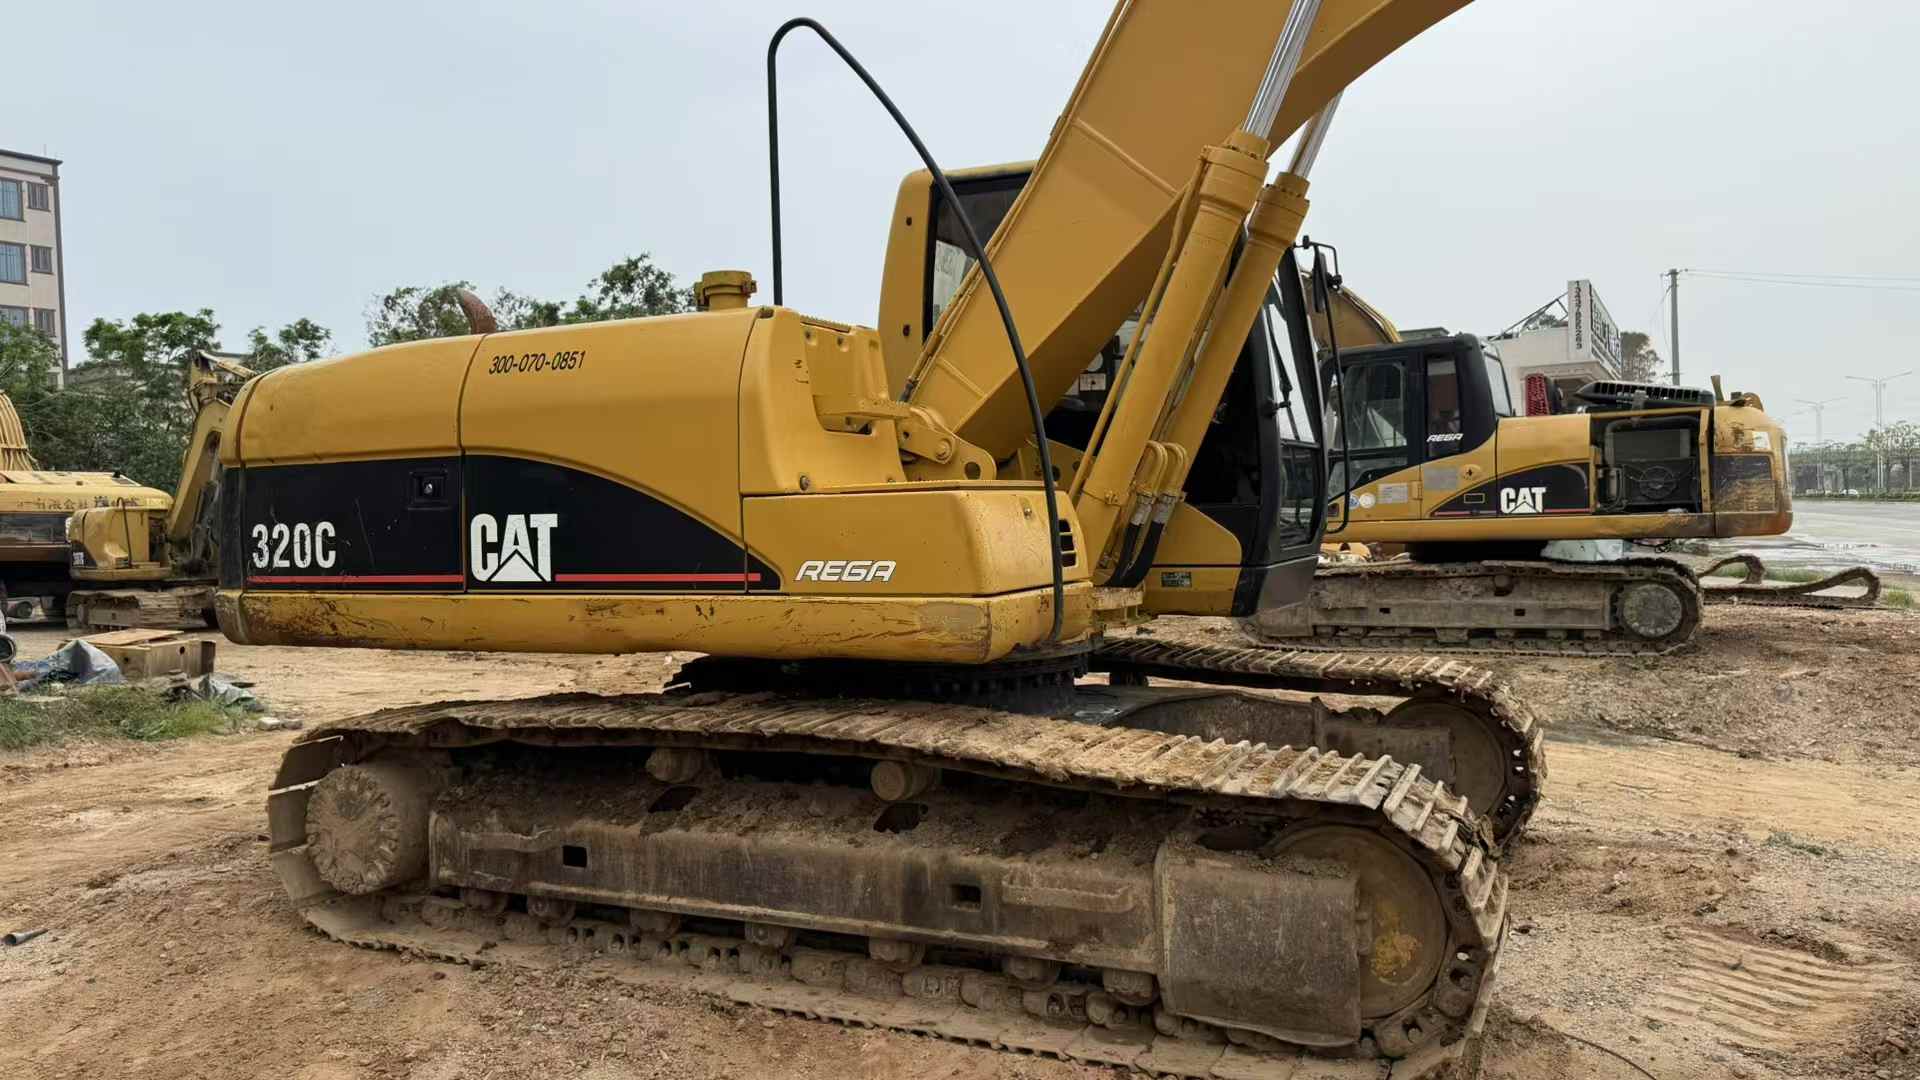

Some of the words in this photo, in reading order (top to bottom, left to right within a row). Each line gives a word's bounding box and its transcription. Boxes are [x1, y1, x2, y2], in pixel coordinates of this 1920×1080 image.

[489, 351, 585, 374] 300-070-0851
[1426, 433, 1464, 443] REGA
[1501, 487, 1547, 514] CAT
[252, 522, 336, 569] 320C
[471, 513, 558, 582] CAT
[794, 560, 897, 581] REGA
